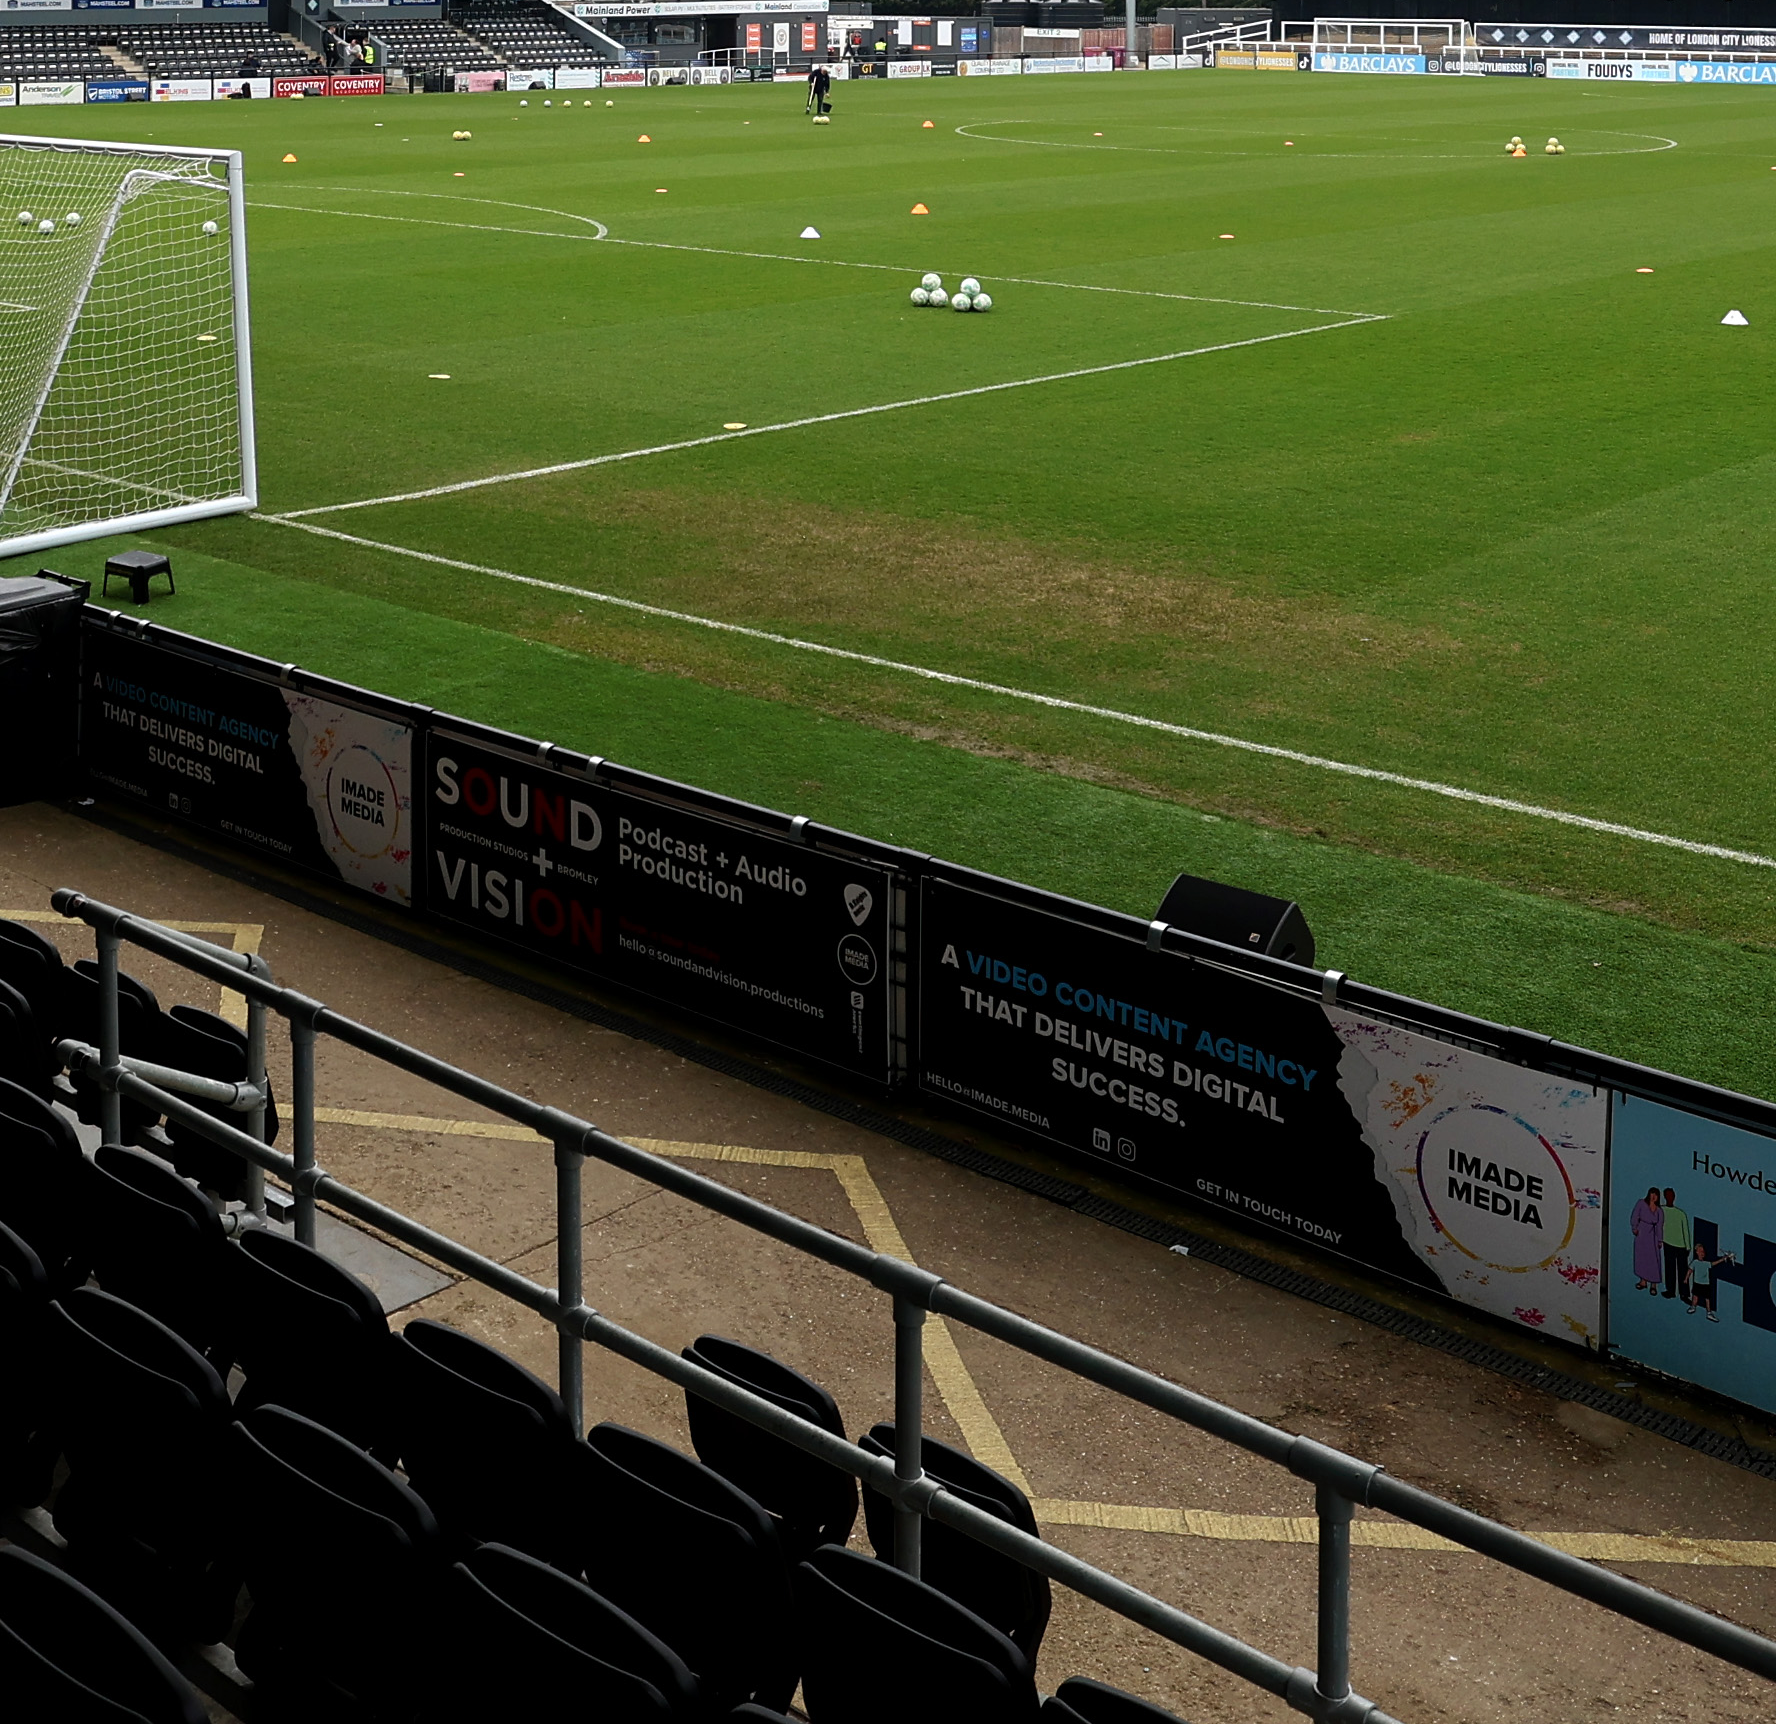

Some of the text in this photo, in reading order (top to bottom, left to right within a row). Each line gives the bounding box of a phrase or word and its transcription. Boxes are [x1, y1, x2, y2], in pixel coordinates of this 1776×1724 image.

[585, 5, 652, 16] Mainland Power
[1339, 56, 1416, 73] BARCLAYS
[1649, 32, 1673, 45] HOME
[1674, 33, 1685, 45] OF
[1686, 33, 1720, 46] LONDON
[1722, 34, 1743, 46] CITY
[22, 84, 62, 96] Anderson
[333, 78, 381, 90] COVENTRY
[1587, 63, 1633, 78] FOUDYS
[92, 671, 279, 751] A VIDEO CONTENT AGENCY
[102, 700, 264, 775] THAT DELIVERS DIGITAL
[148, 744, 216, 786] SUCCESS.
[340, 777, 386, 808] IMADE
[340, 798, 386, 828] MEDIA
[434, 756, 603, 854] SOUND
[439, 821, 529, 862] PRODUCTION STUDIOS
[618, 816, 808, 898] Podcast Audio
[557, 864, 599, 887] BROMLEY
[618, 842, 744, 906] Production
[434, 849, 604, 956] VISION
[618, 933, 825, 1020] hello@soundandvision.productions
[843, 946, 871, 962] IMADE
[843, 954, 871, 971] MEDIA
[940, 942, 1318, 1094] A VIDEO CONTENT AGENCY
[959, 983, 1286, 1126] THAT DELIVERS DIGITAL
[926, 1070, 1051, 1131] HELLO@IMADE.MEDIA
[1050, 1056, 1187, 1130] SUCCESS.
[1446, 1146, 1545, 1203] IMADE
[1195, 1177, 1344, 1247] GET IN TOUCH TODAY
[1446, 1175, 1544, 1231] MEDIA
